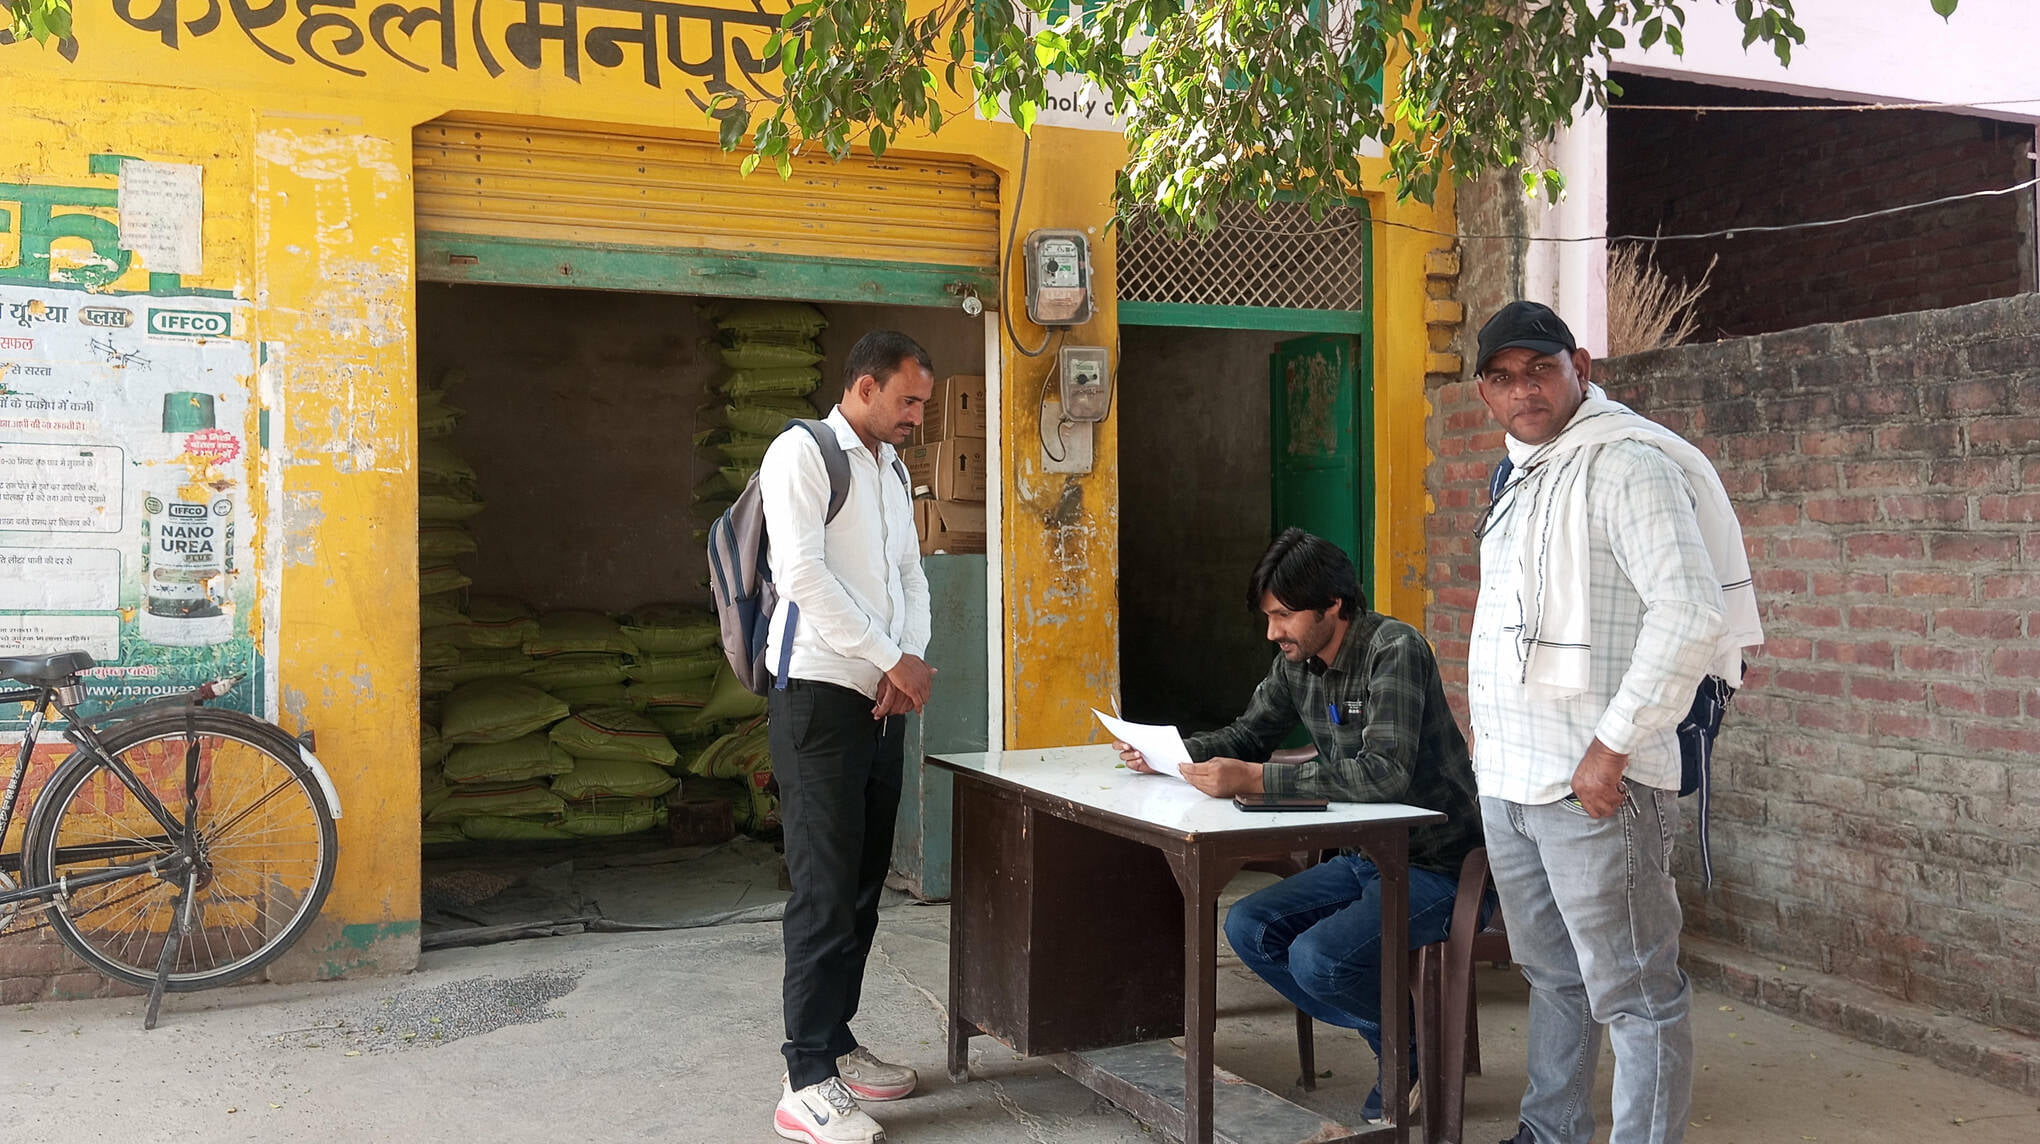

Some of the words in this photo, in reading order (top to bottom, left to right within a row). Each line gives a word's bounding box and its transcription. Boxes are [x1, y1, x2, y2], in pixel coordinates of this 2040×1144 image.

[86, 309, 126, 326] प्लस
[161, 315, 219, 331] IFFCO
[24, 366, 52, 376] सस्ता
[70, 400, 94, 412] कमी
[174, 507, 203, 515] IFFCO
[161, 525, 214, 539] NANO
[161, 539, 214, 554] UREA
